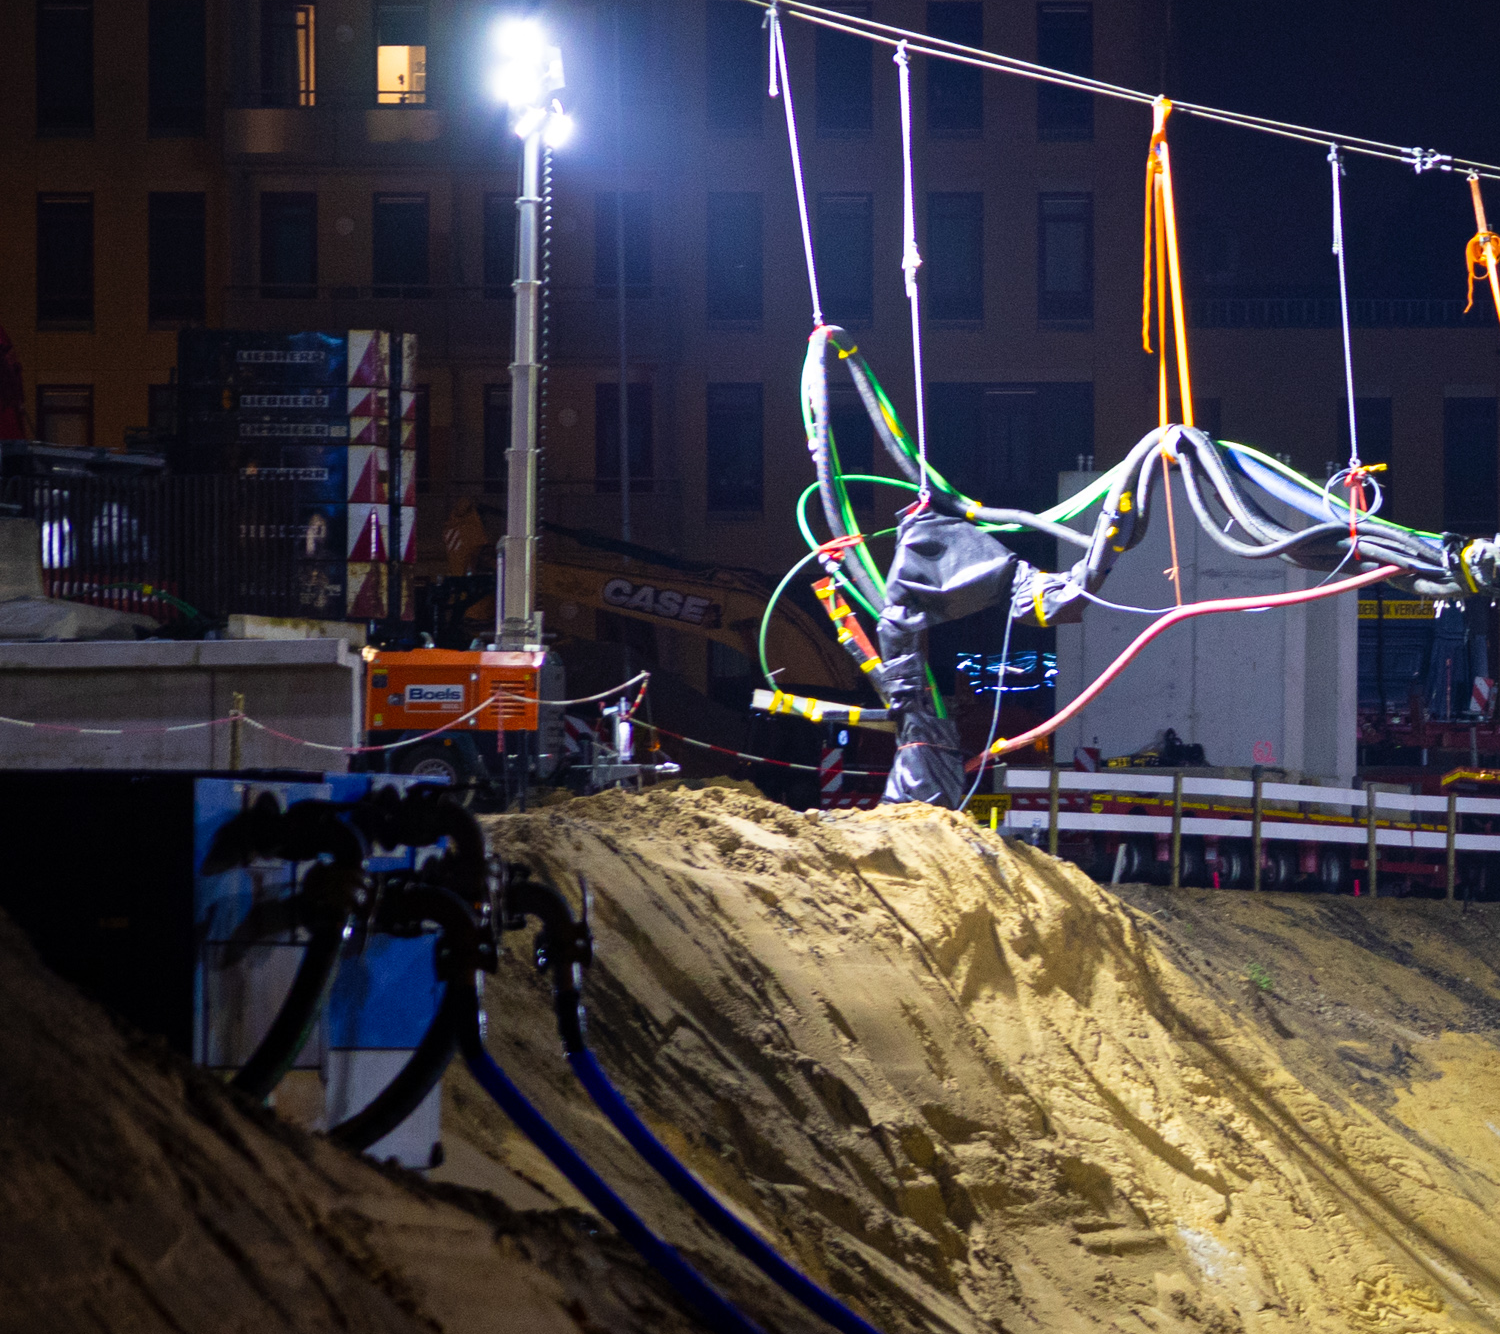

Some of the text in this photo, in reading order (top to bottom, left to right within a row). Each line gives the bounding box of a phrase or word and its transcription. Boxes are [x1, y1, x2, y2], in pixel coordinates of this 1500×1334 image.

[238, 351, 324, 363] LIEBHERR
[241, 395, 329, 407] LIEBHERR
[604, 579, 710, 624] CASE
[409, 688, 461, 700] Boels
